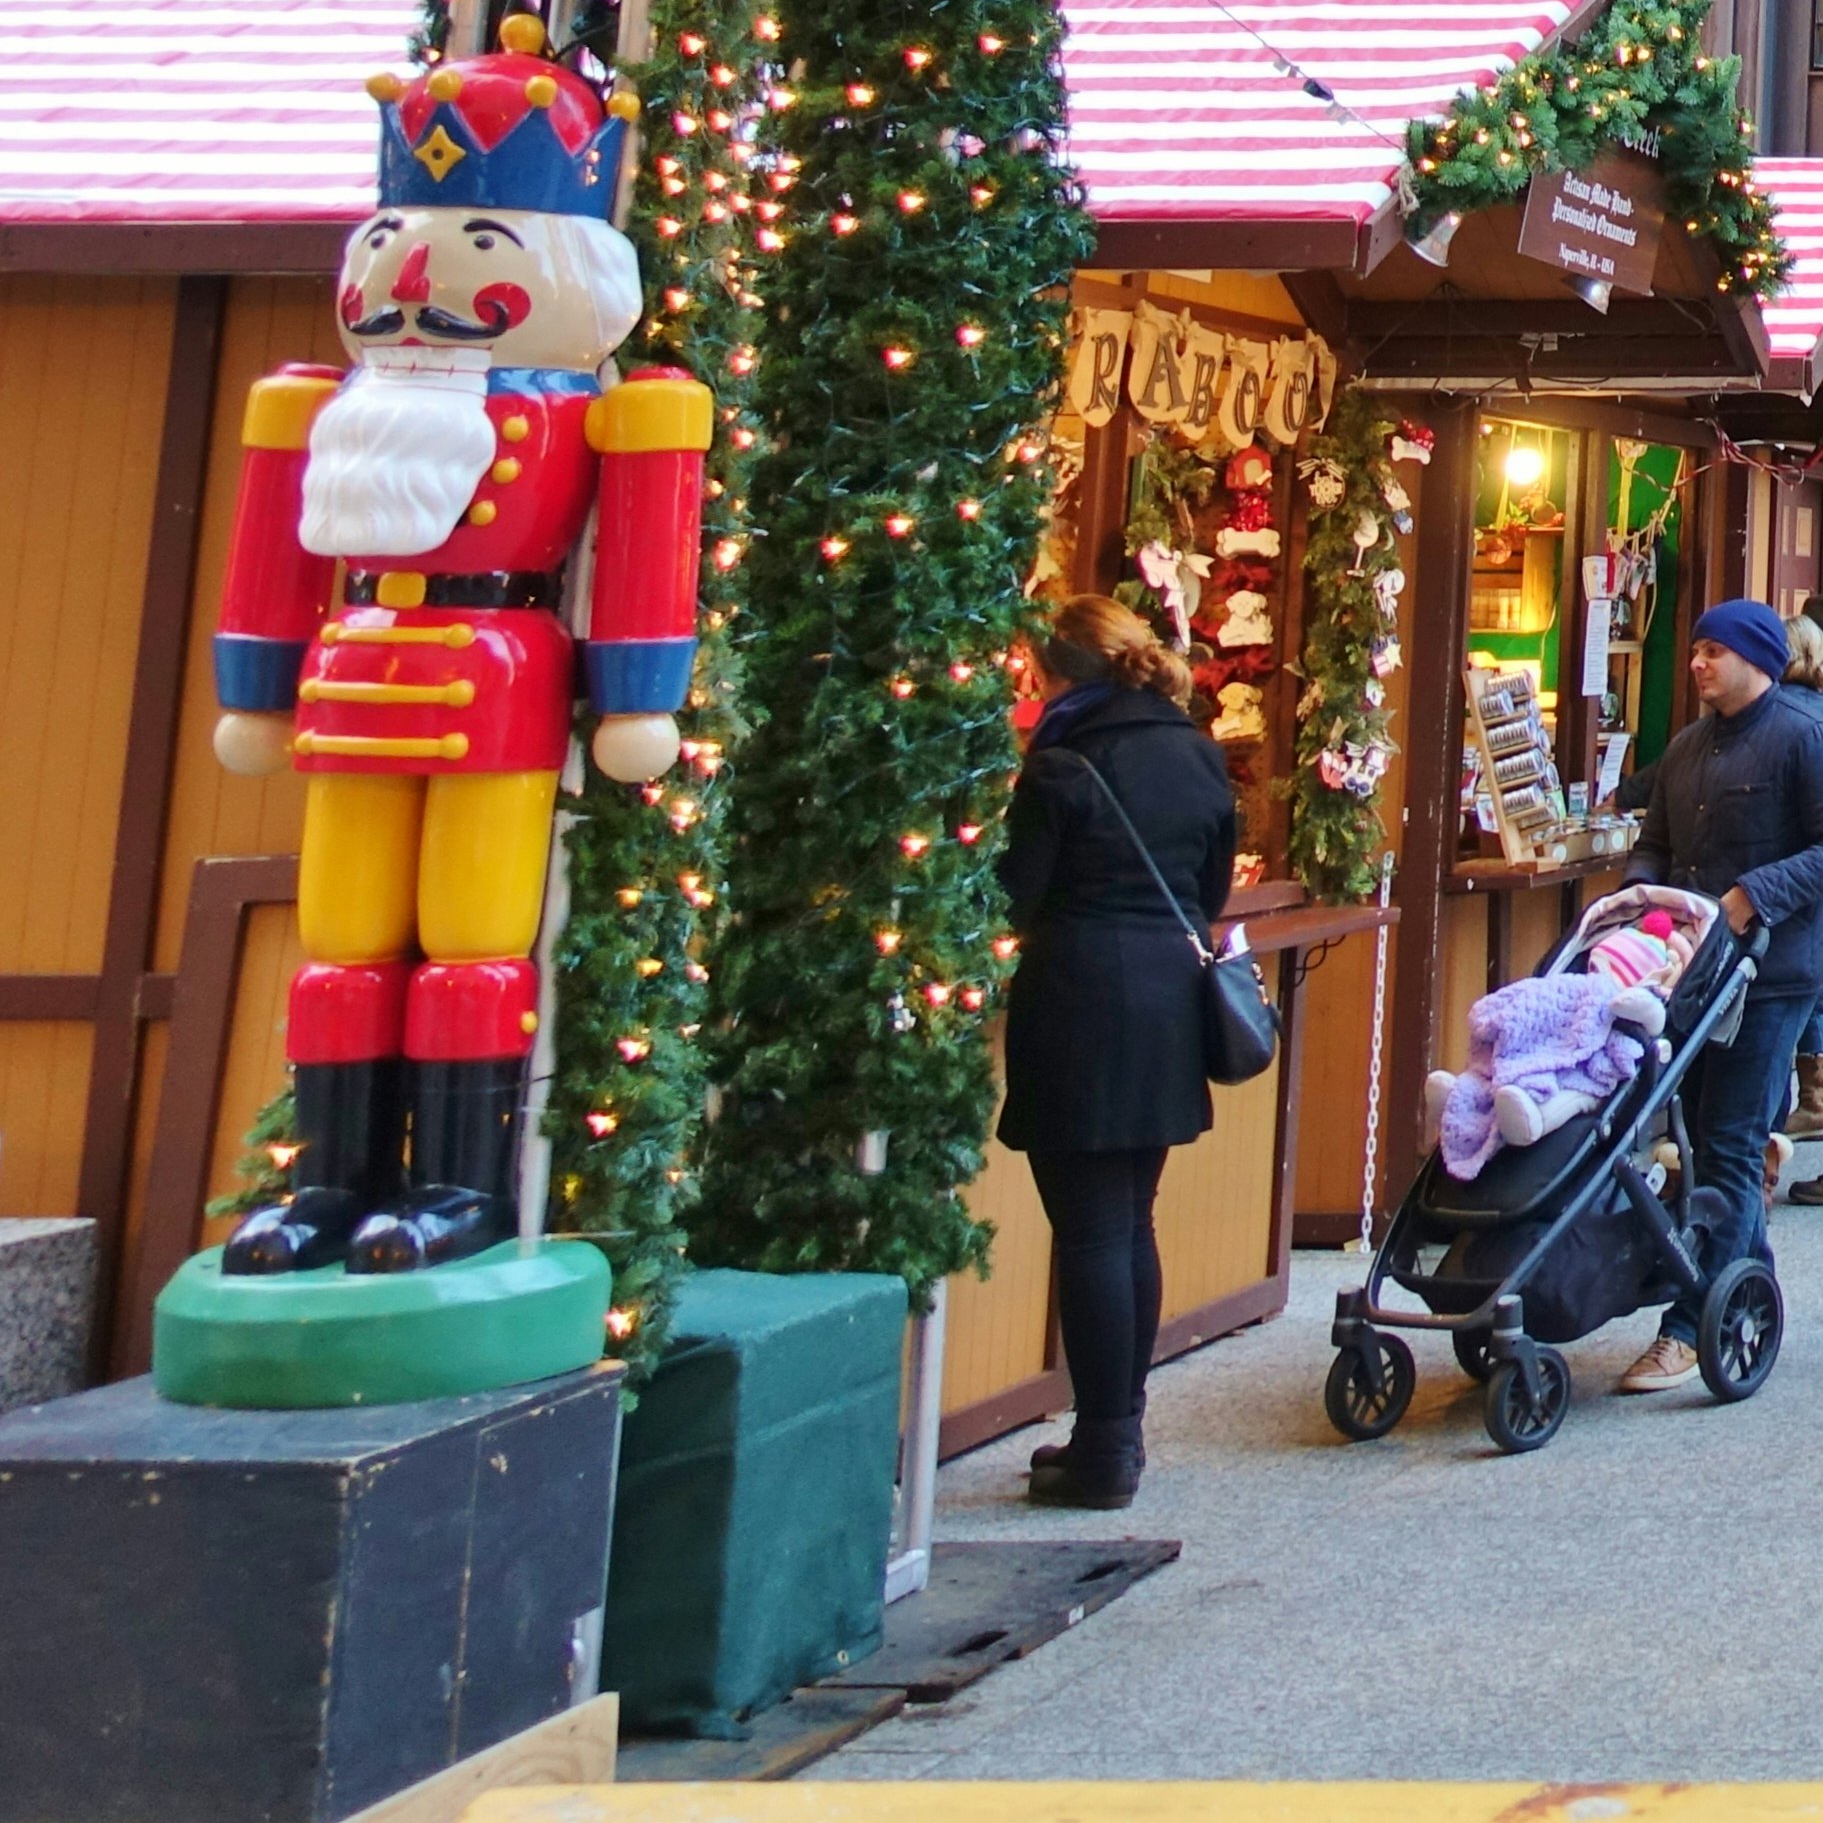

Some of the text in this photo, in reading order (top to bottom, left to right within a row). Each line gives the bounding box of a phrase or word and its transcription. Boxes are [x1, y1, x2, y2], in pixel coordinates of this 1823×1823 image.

[1563, 171, 1590, 199] Artisan
[1590, 183, 1611, 207] Made
[1552, 197, 1637, 246] Personalized Ornaments
